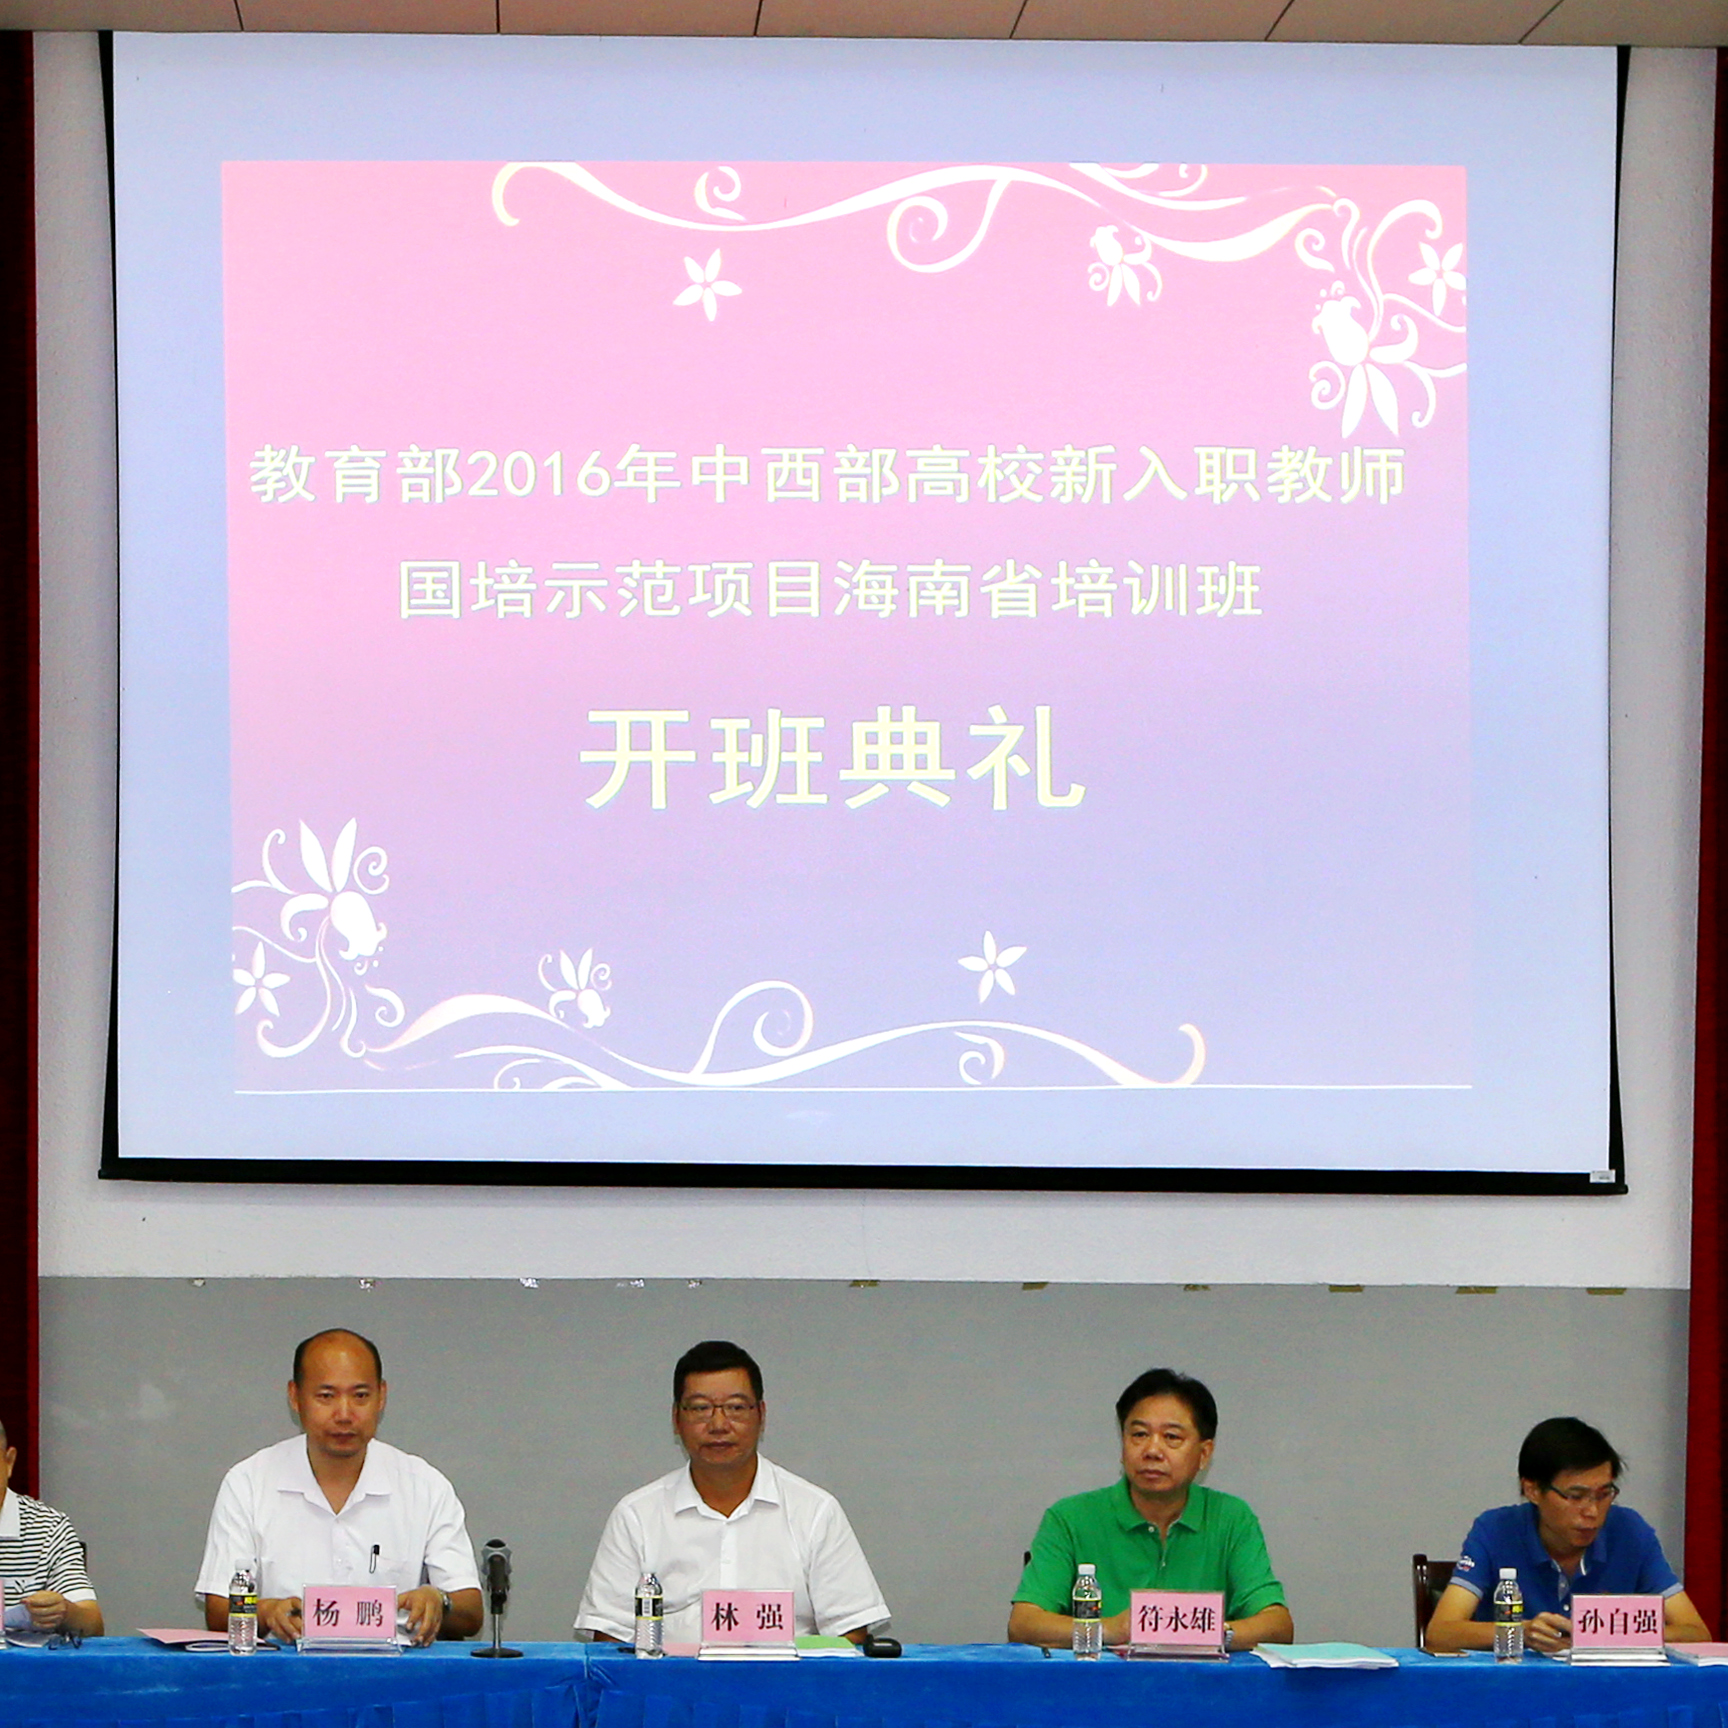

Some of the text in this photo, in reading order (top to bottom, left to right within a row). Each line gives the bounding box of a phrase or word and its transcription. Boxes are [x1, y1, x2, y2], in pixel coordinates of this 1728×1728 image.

[249, 442, 1407, 506] 教育部2016年中西部高校新入职教师
[396, 557, 1263, 619] 国培示范项目海南省培训班
[579, 704, 1087, 810] 开班典礼
[312, 1599, 383, 1628] 杨鹏
[710, 1602, 784, 1632] 林强
[1137, 1604, 1216, 1633] 符永雄
[1578, 1608, 1659, 1636] 孙自强
